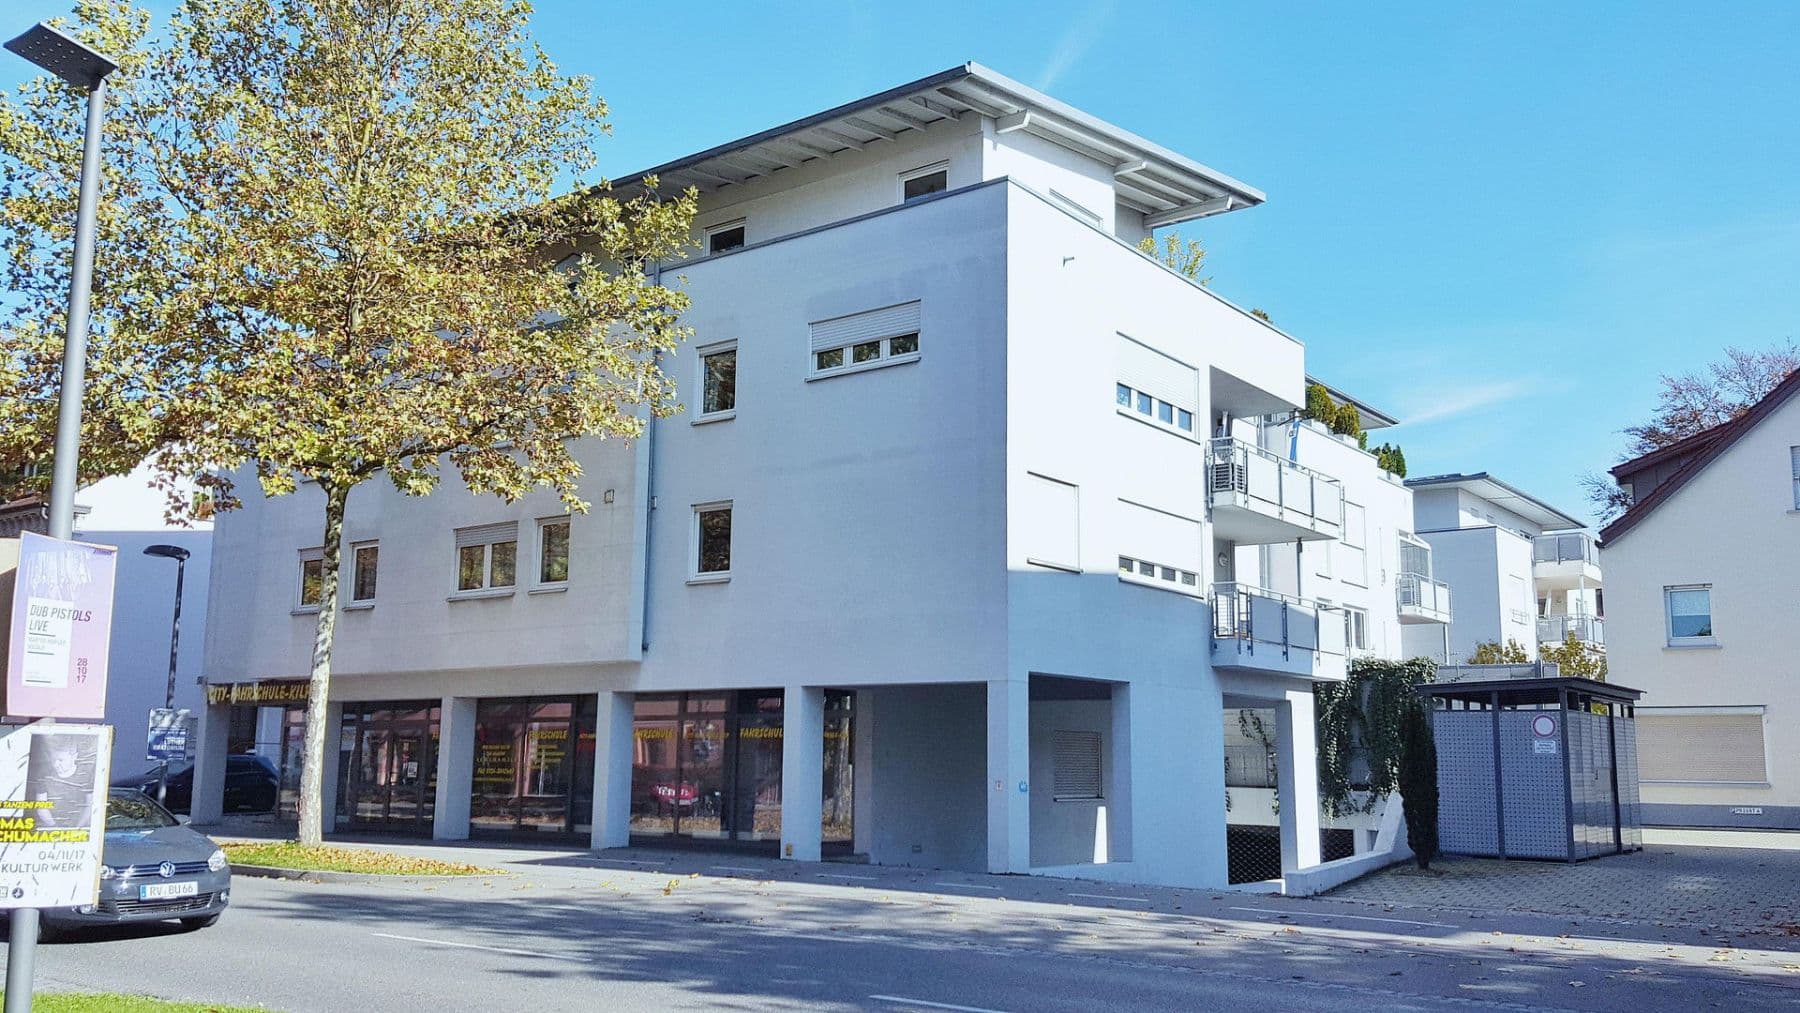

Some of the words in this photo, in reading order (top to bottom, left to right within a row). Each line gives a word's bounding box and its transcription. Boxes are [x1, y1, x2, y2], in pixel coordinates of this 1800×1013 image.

[30, 604, 49, 618] DUB
[50, 607, 92, 622] PISTOLS
[28, 619, 49, 632] LIVE
[77, 657, 88, 667] 28
[77, 667, 87, 675] 10
[77, 676, 86, 684] 17
[38, 850, 86, 861] 04/11/17
[150, 886, 162, 896] RV
